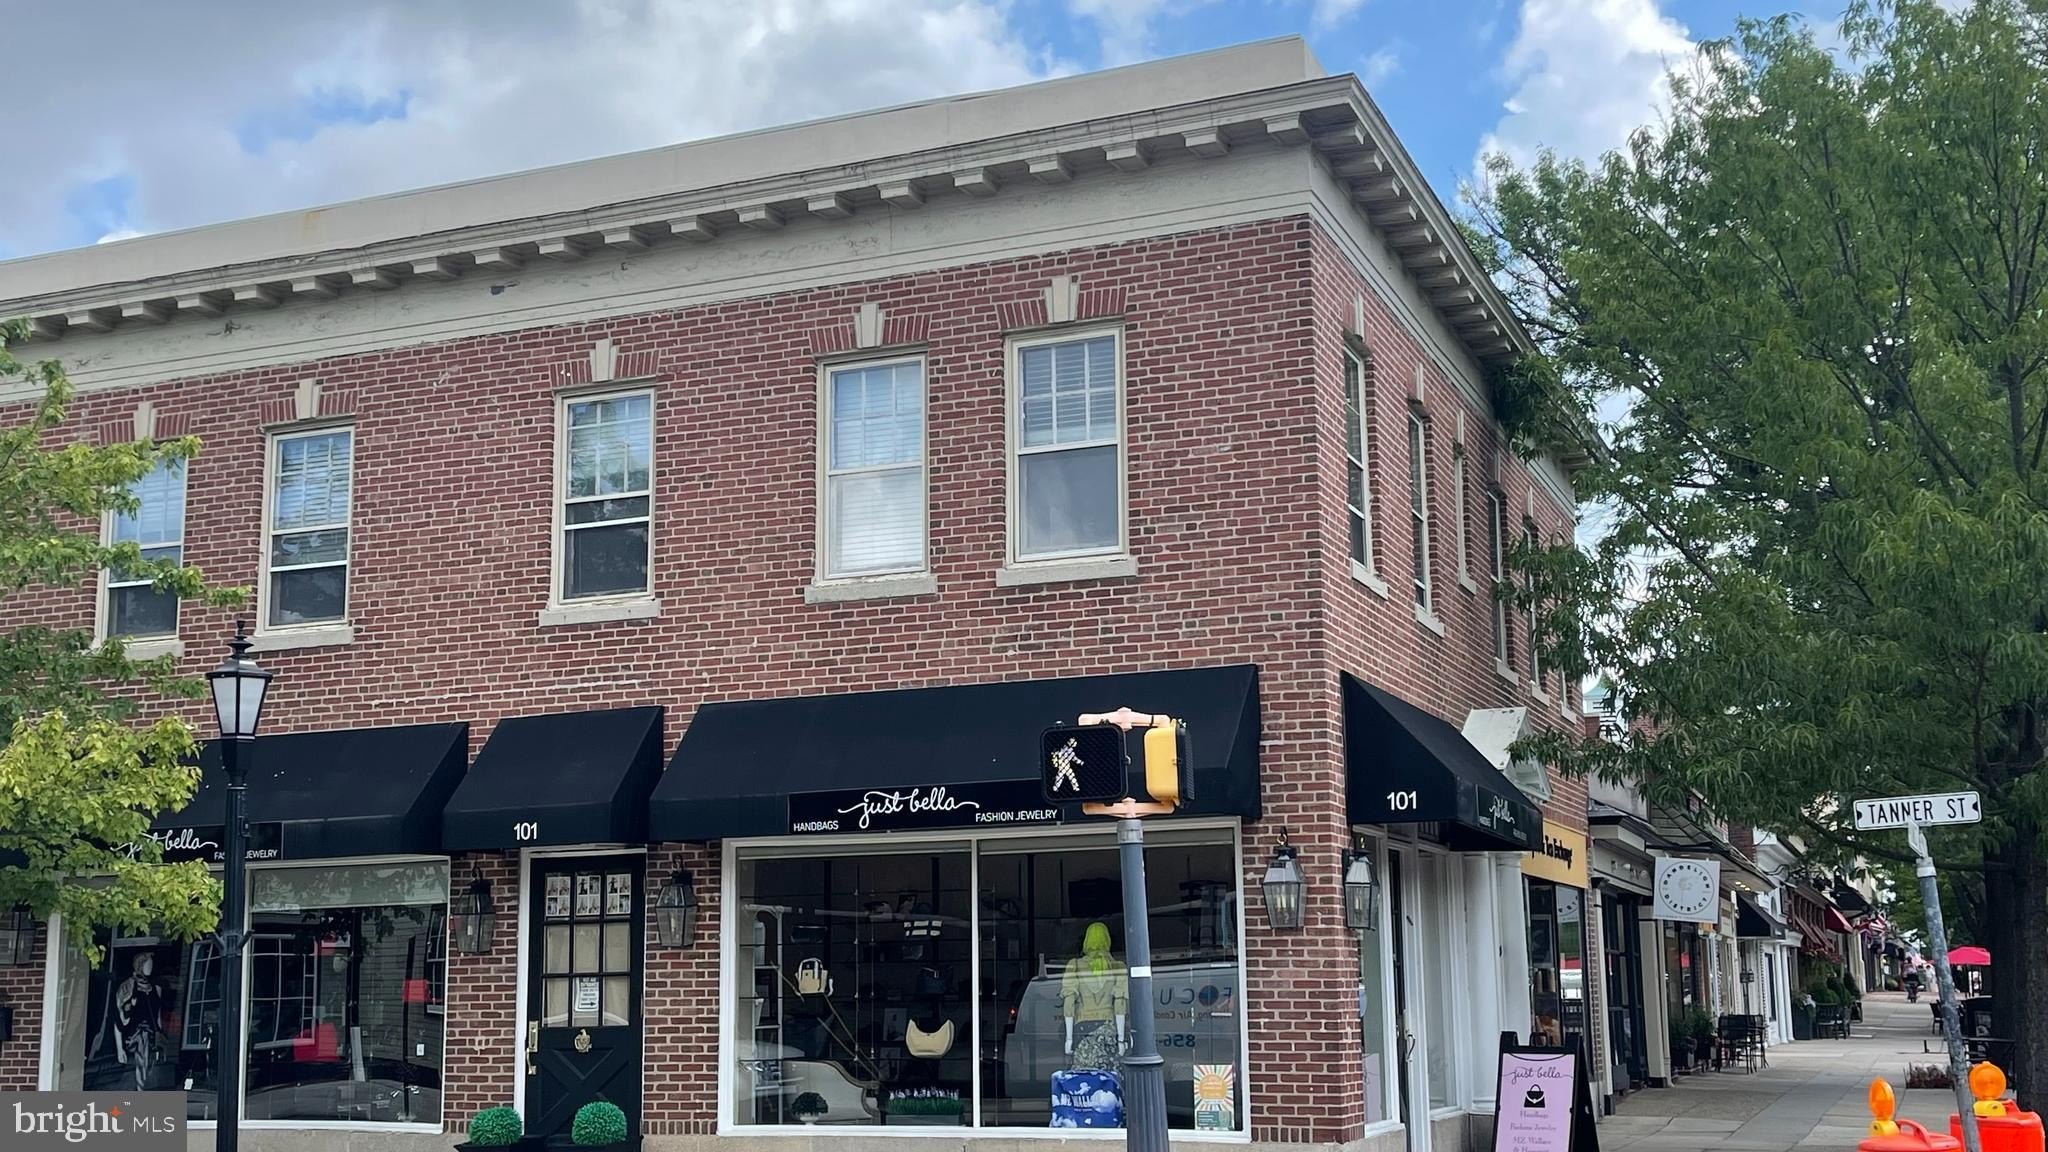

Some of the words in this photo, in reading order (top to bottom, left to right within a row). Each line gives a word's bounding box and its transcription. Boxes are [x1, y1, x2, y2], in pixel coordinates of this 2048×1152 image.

[837, 791, 904, 829] just
[909, 786, 980, 813] bella
[1386, 790, 1418, 811] 101
[1867, 800, 1934, 824] TANNER
[1946, 797, 1966, 819] ST
[793, 820, 839, 832] HANDBAGS
[975, 811, 1014, 823] FASHION
[1015, 809, 1058, 821] JEWELRY
[163, 828, 219, 850] bella
[513, 822, 538, 841] 101
[1663, 864, 1711, 889] DANDELION
[1663, 894, 1708, 912] DISTRICT
[1502, 1066, 1534, 1085] just
[1536, 1066, 1574, 1079] bella
